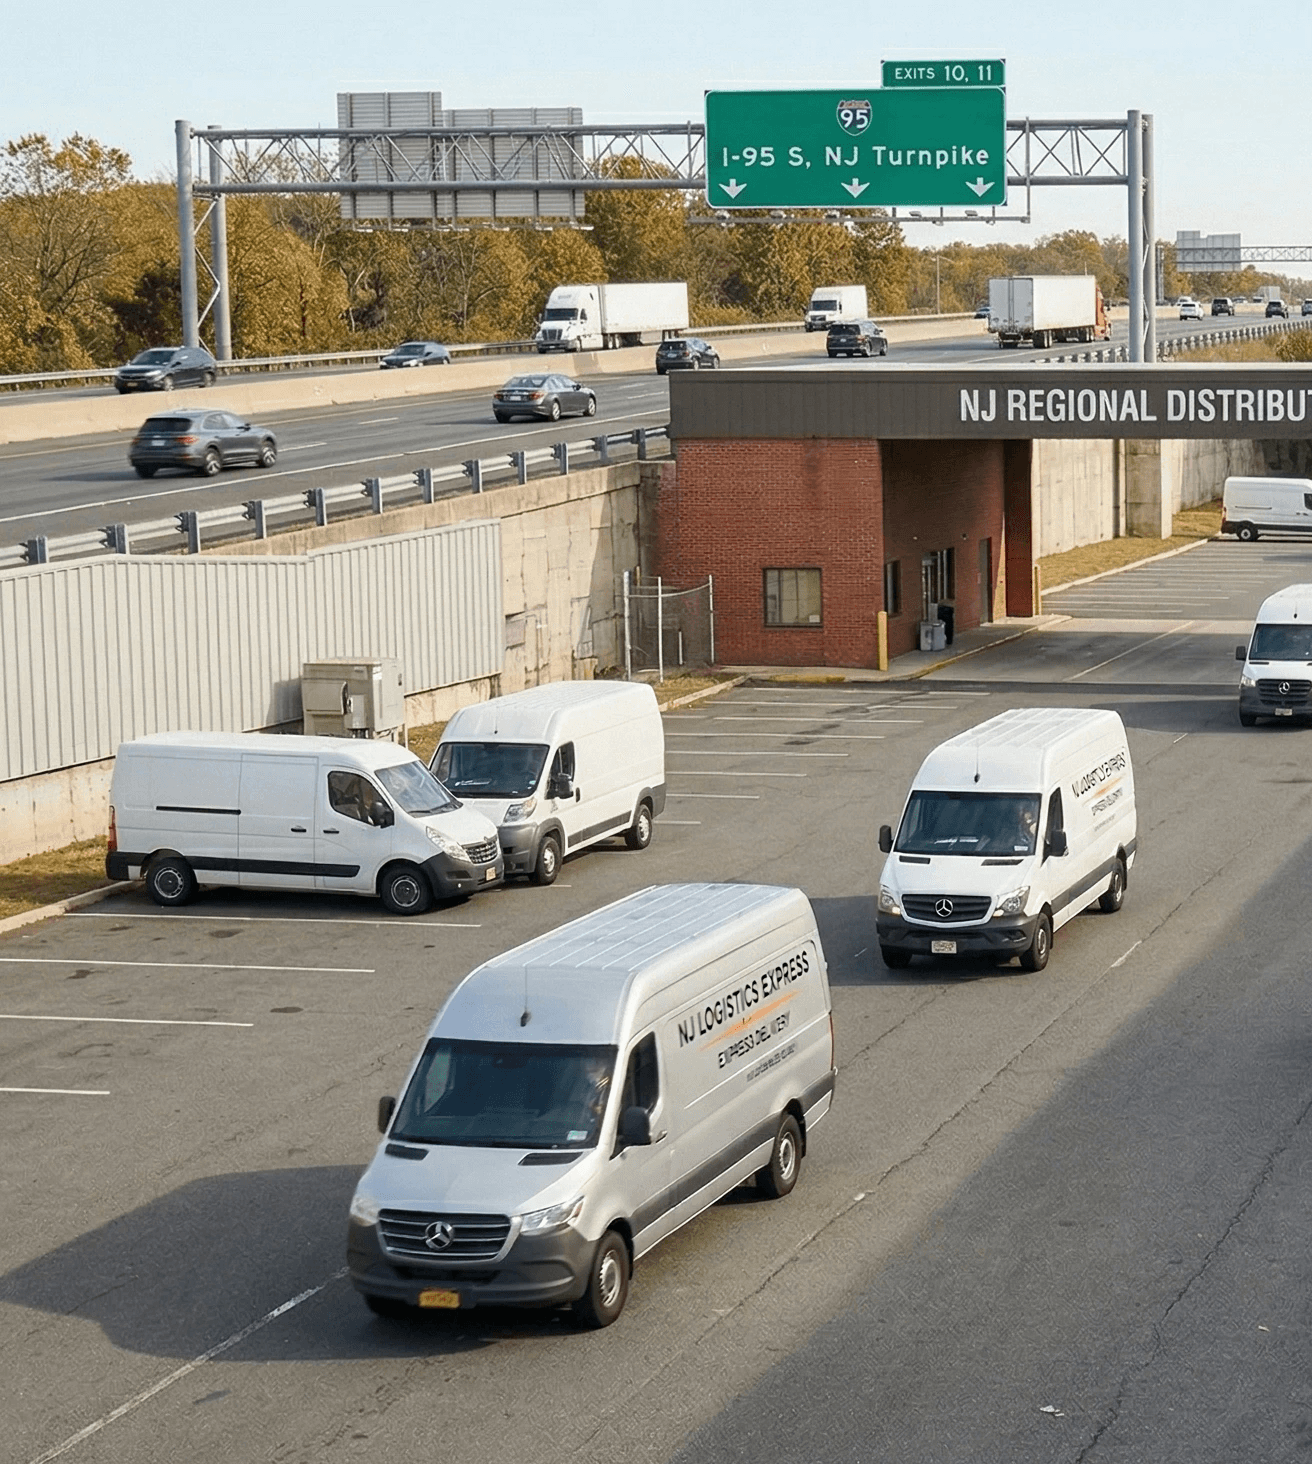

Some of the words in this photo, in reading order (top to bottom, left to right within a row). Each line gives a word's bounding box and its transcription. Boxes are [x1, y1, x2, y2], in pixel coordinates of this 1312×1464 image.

[894, 67, 935, 80] EXITS
[944, 64, 969, 82] 10,
[978, 64, 992, 81] 11
[840, 109, 869, 129] 95
[722, 147, 775, 167] I-95
[788, 147, 811, 169] S,
[825, 147, 859, 166] NJ
[872, 145, 990, 170] Turnpike
[960, 389, 997, 422] NJ
[1007, 388, 1158, 422] REGIONAL
[678, 1015, 696, 1048] NJ
[697, 980, 759, 1036] LOGISTICS
[761, 951, 810, 998] EXPRESS
